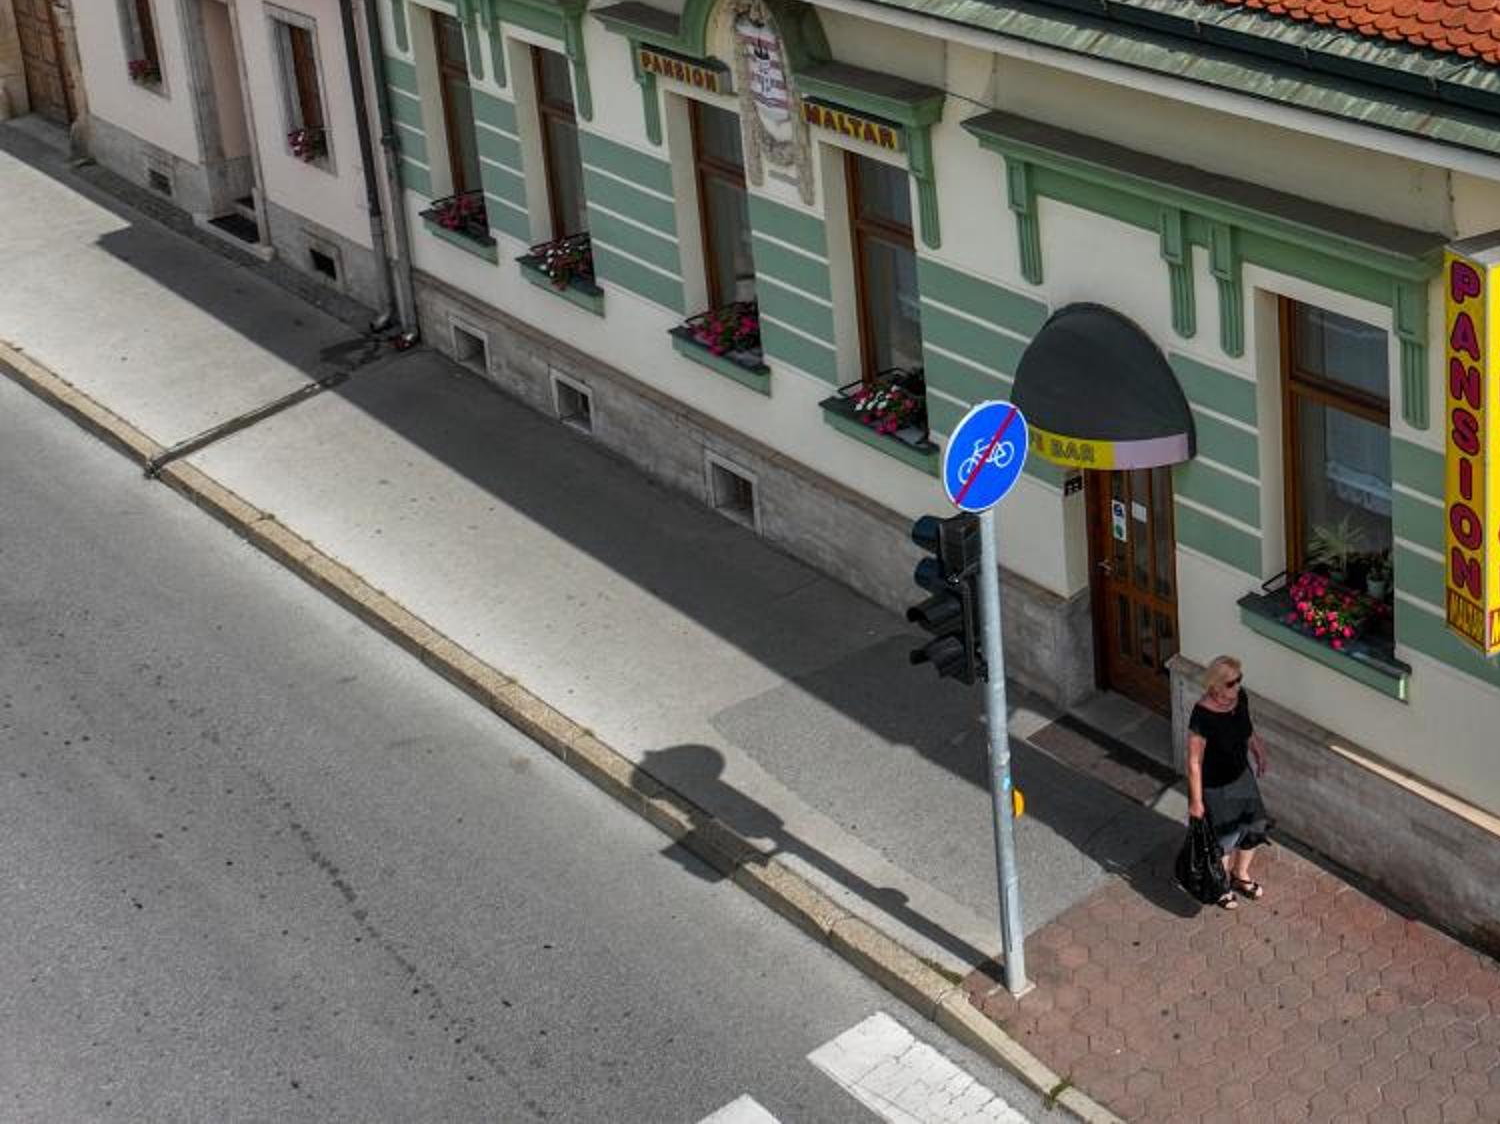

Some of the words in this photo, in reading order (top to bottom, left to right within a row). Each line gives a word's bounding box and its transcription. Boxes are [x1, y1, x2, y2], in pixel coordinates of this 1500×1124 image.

[640, 51, 717, 92] PANSION
[803, 103, 896, 150] MALTAR
[1051, 438, 1095, 463] BAR
[1449, 261, 1483, 601] PANSION
